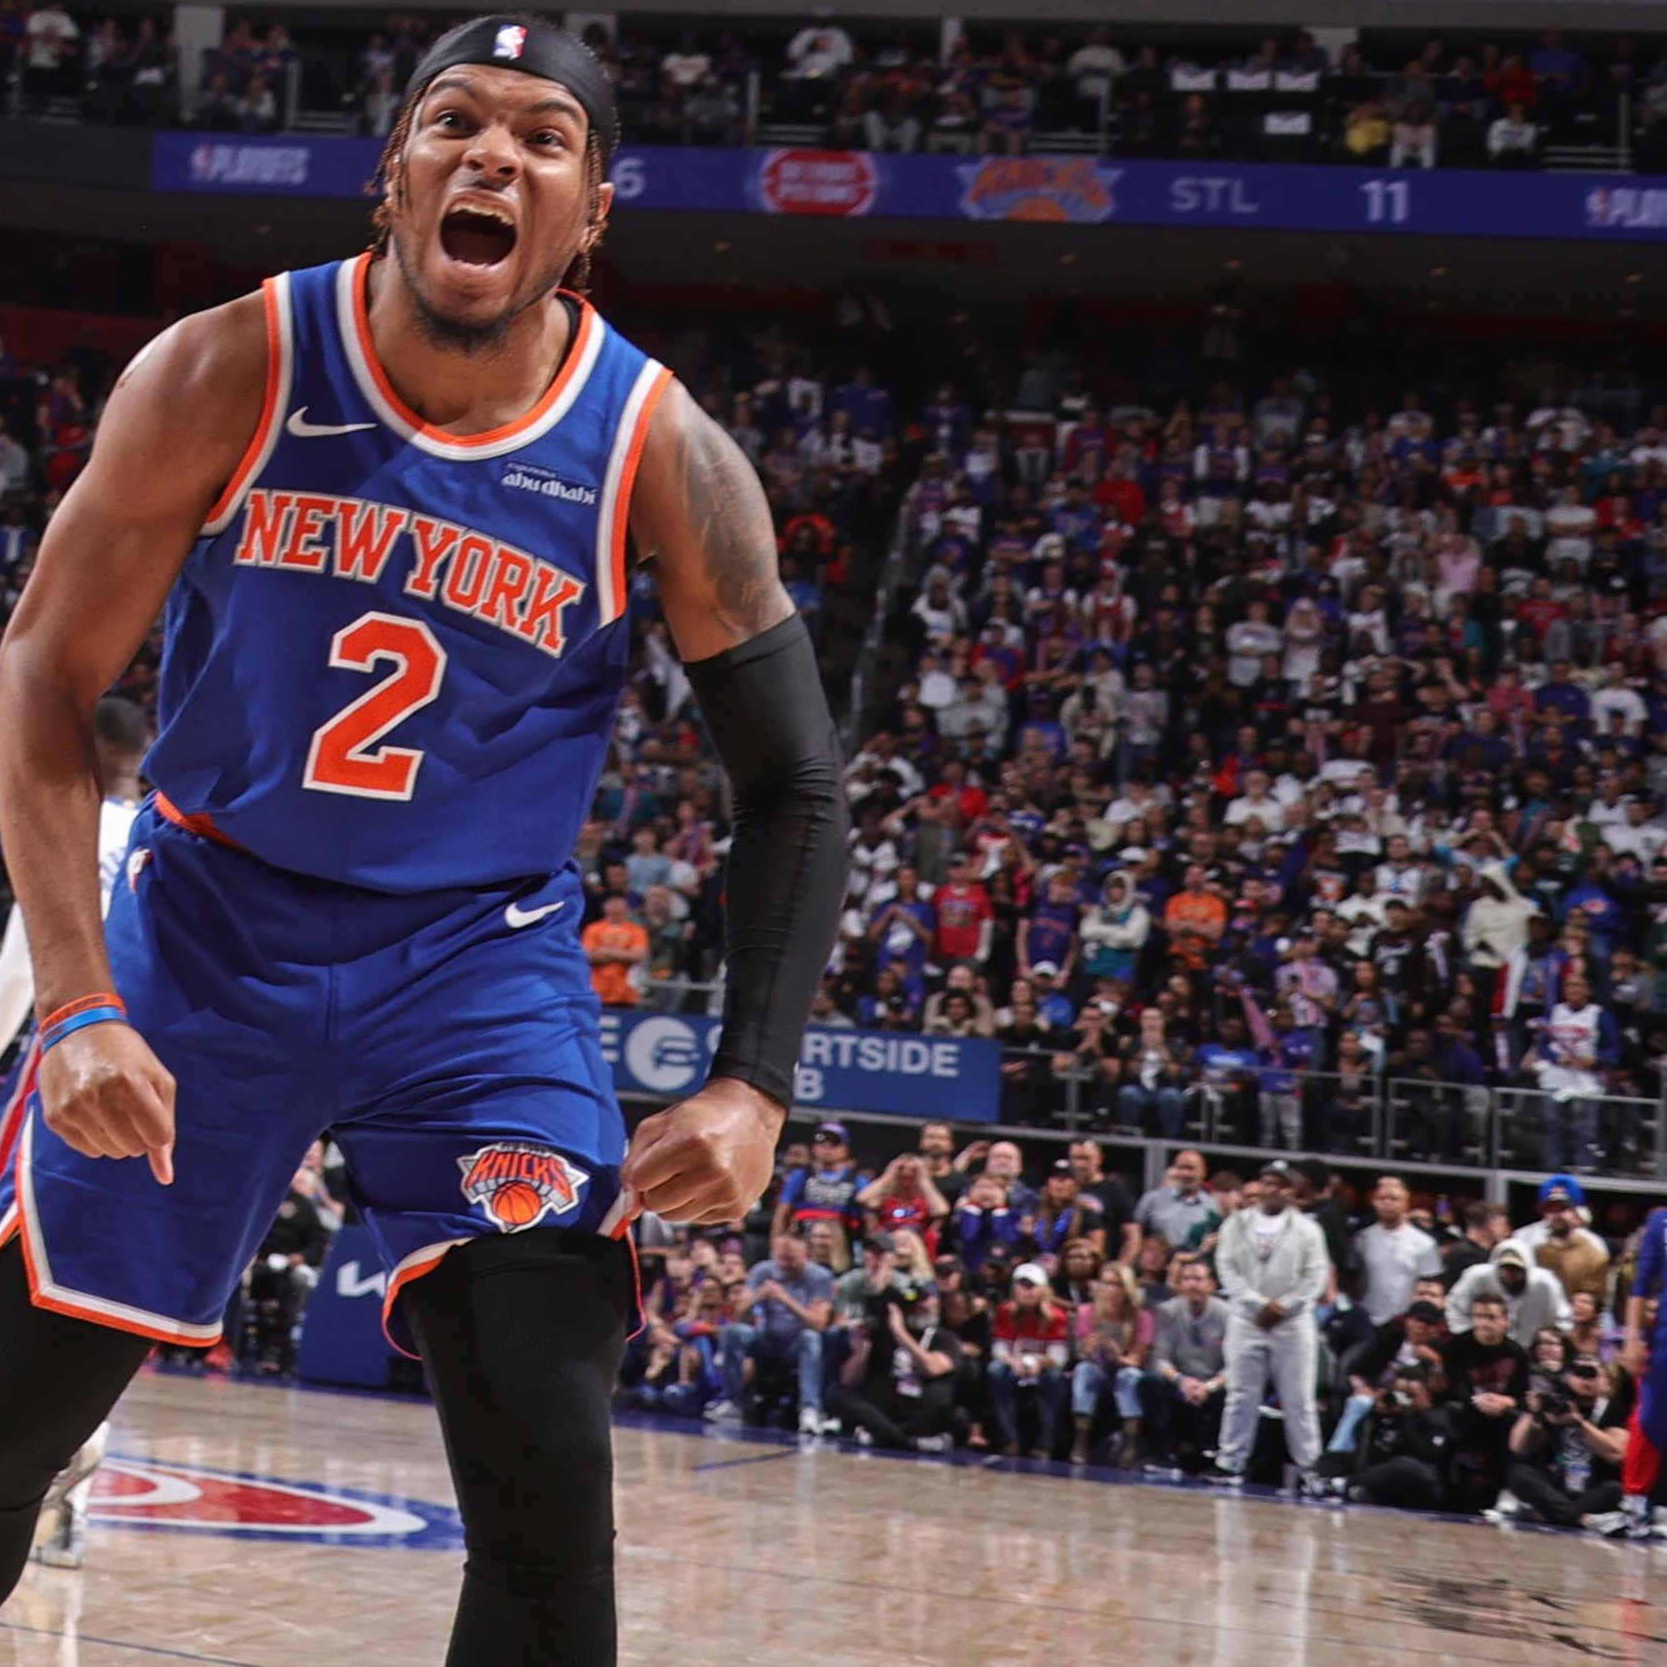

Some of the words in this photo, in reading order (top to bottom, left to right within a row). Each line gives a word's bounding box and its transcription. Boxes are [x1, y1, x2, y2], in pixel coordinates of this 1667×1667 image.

[1170, 177, 1259, 213] STL
[1361, 180, 1410, 223] 11
[234, 489, 404, 584] NEW
[404, 519, 586, 658] YORK
[303, 611, 448, 801] 2
[802, 1032, 960, 1077] RTSIDE
[464, 1150, 573, 1200] KNICKS
